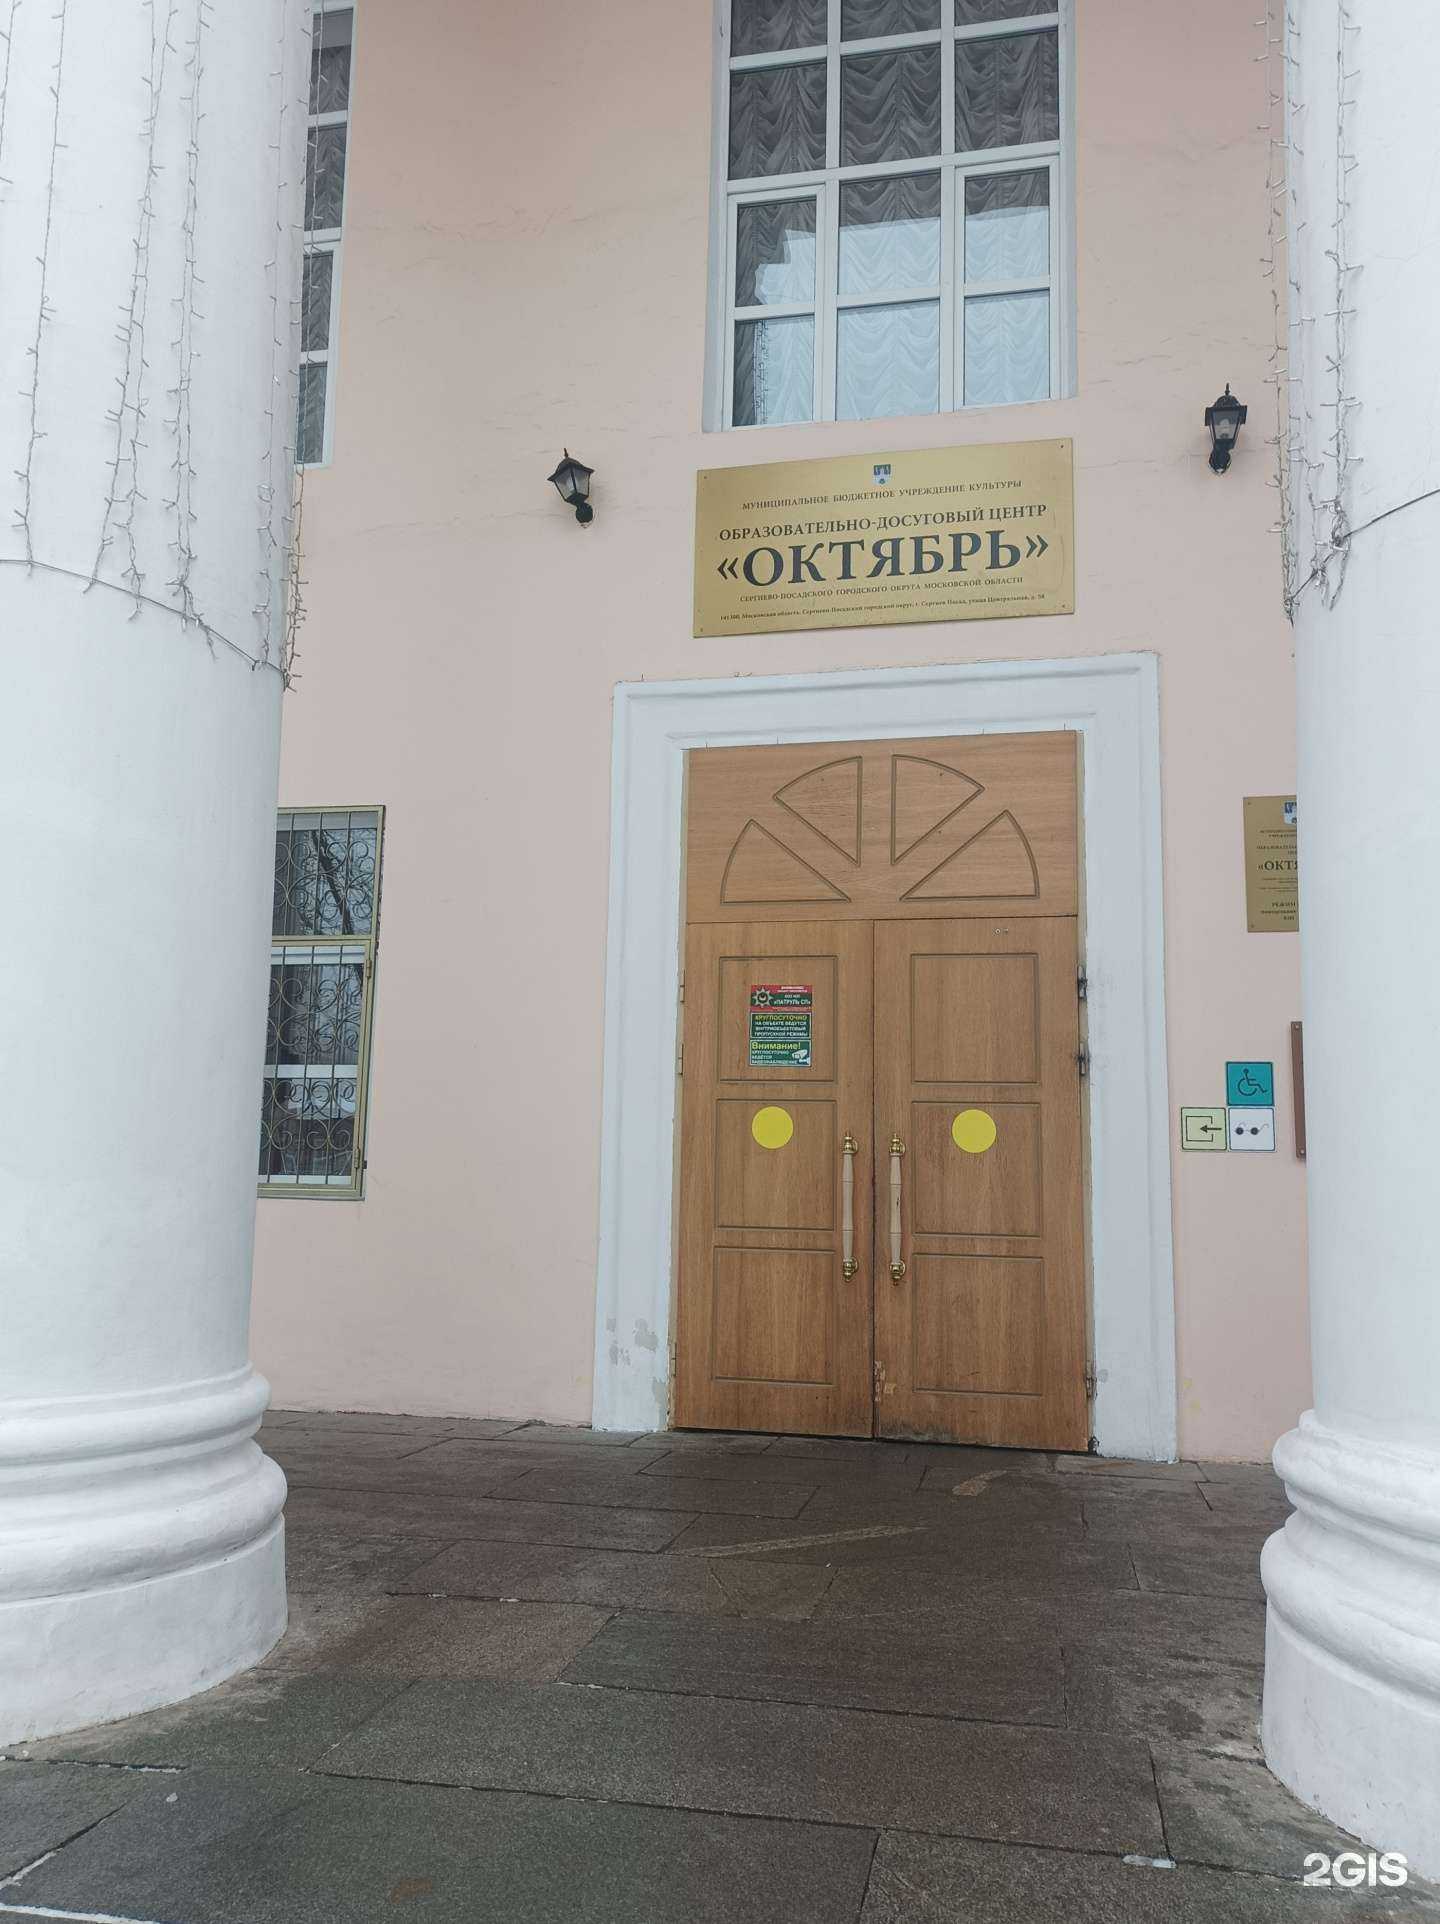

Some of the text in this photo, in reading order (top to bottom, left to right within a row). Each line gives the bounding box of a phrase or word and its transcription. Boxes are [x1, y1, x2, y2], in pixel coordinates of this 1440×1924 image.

[742, 480, 1022, 510] МУНИЦИПАЛЬНОЕ БЮДЖЕТНОЕ УЧРЕЖДЕНИЕ КУЛЬТУРЫ
[719, 504, 1047, 541] ОБРАЗОВАТЕЛЬНО-ДОСУГОВЫЙ ЦЕНТР
[717, 530, 1049, 587] «ОКТЯБРЬ»
[740, 577, 1023, 602] СЕРГИЕВО-ПОСАДСКОГО ГОРОДСКОГО ОКРУГА МОСКОВСКОЙ ОБЛАСТИ
[752, 1041, 801, 1050] Внимание!
